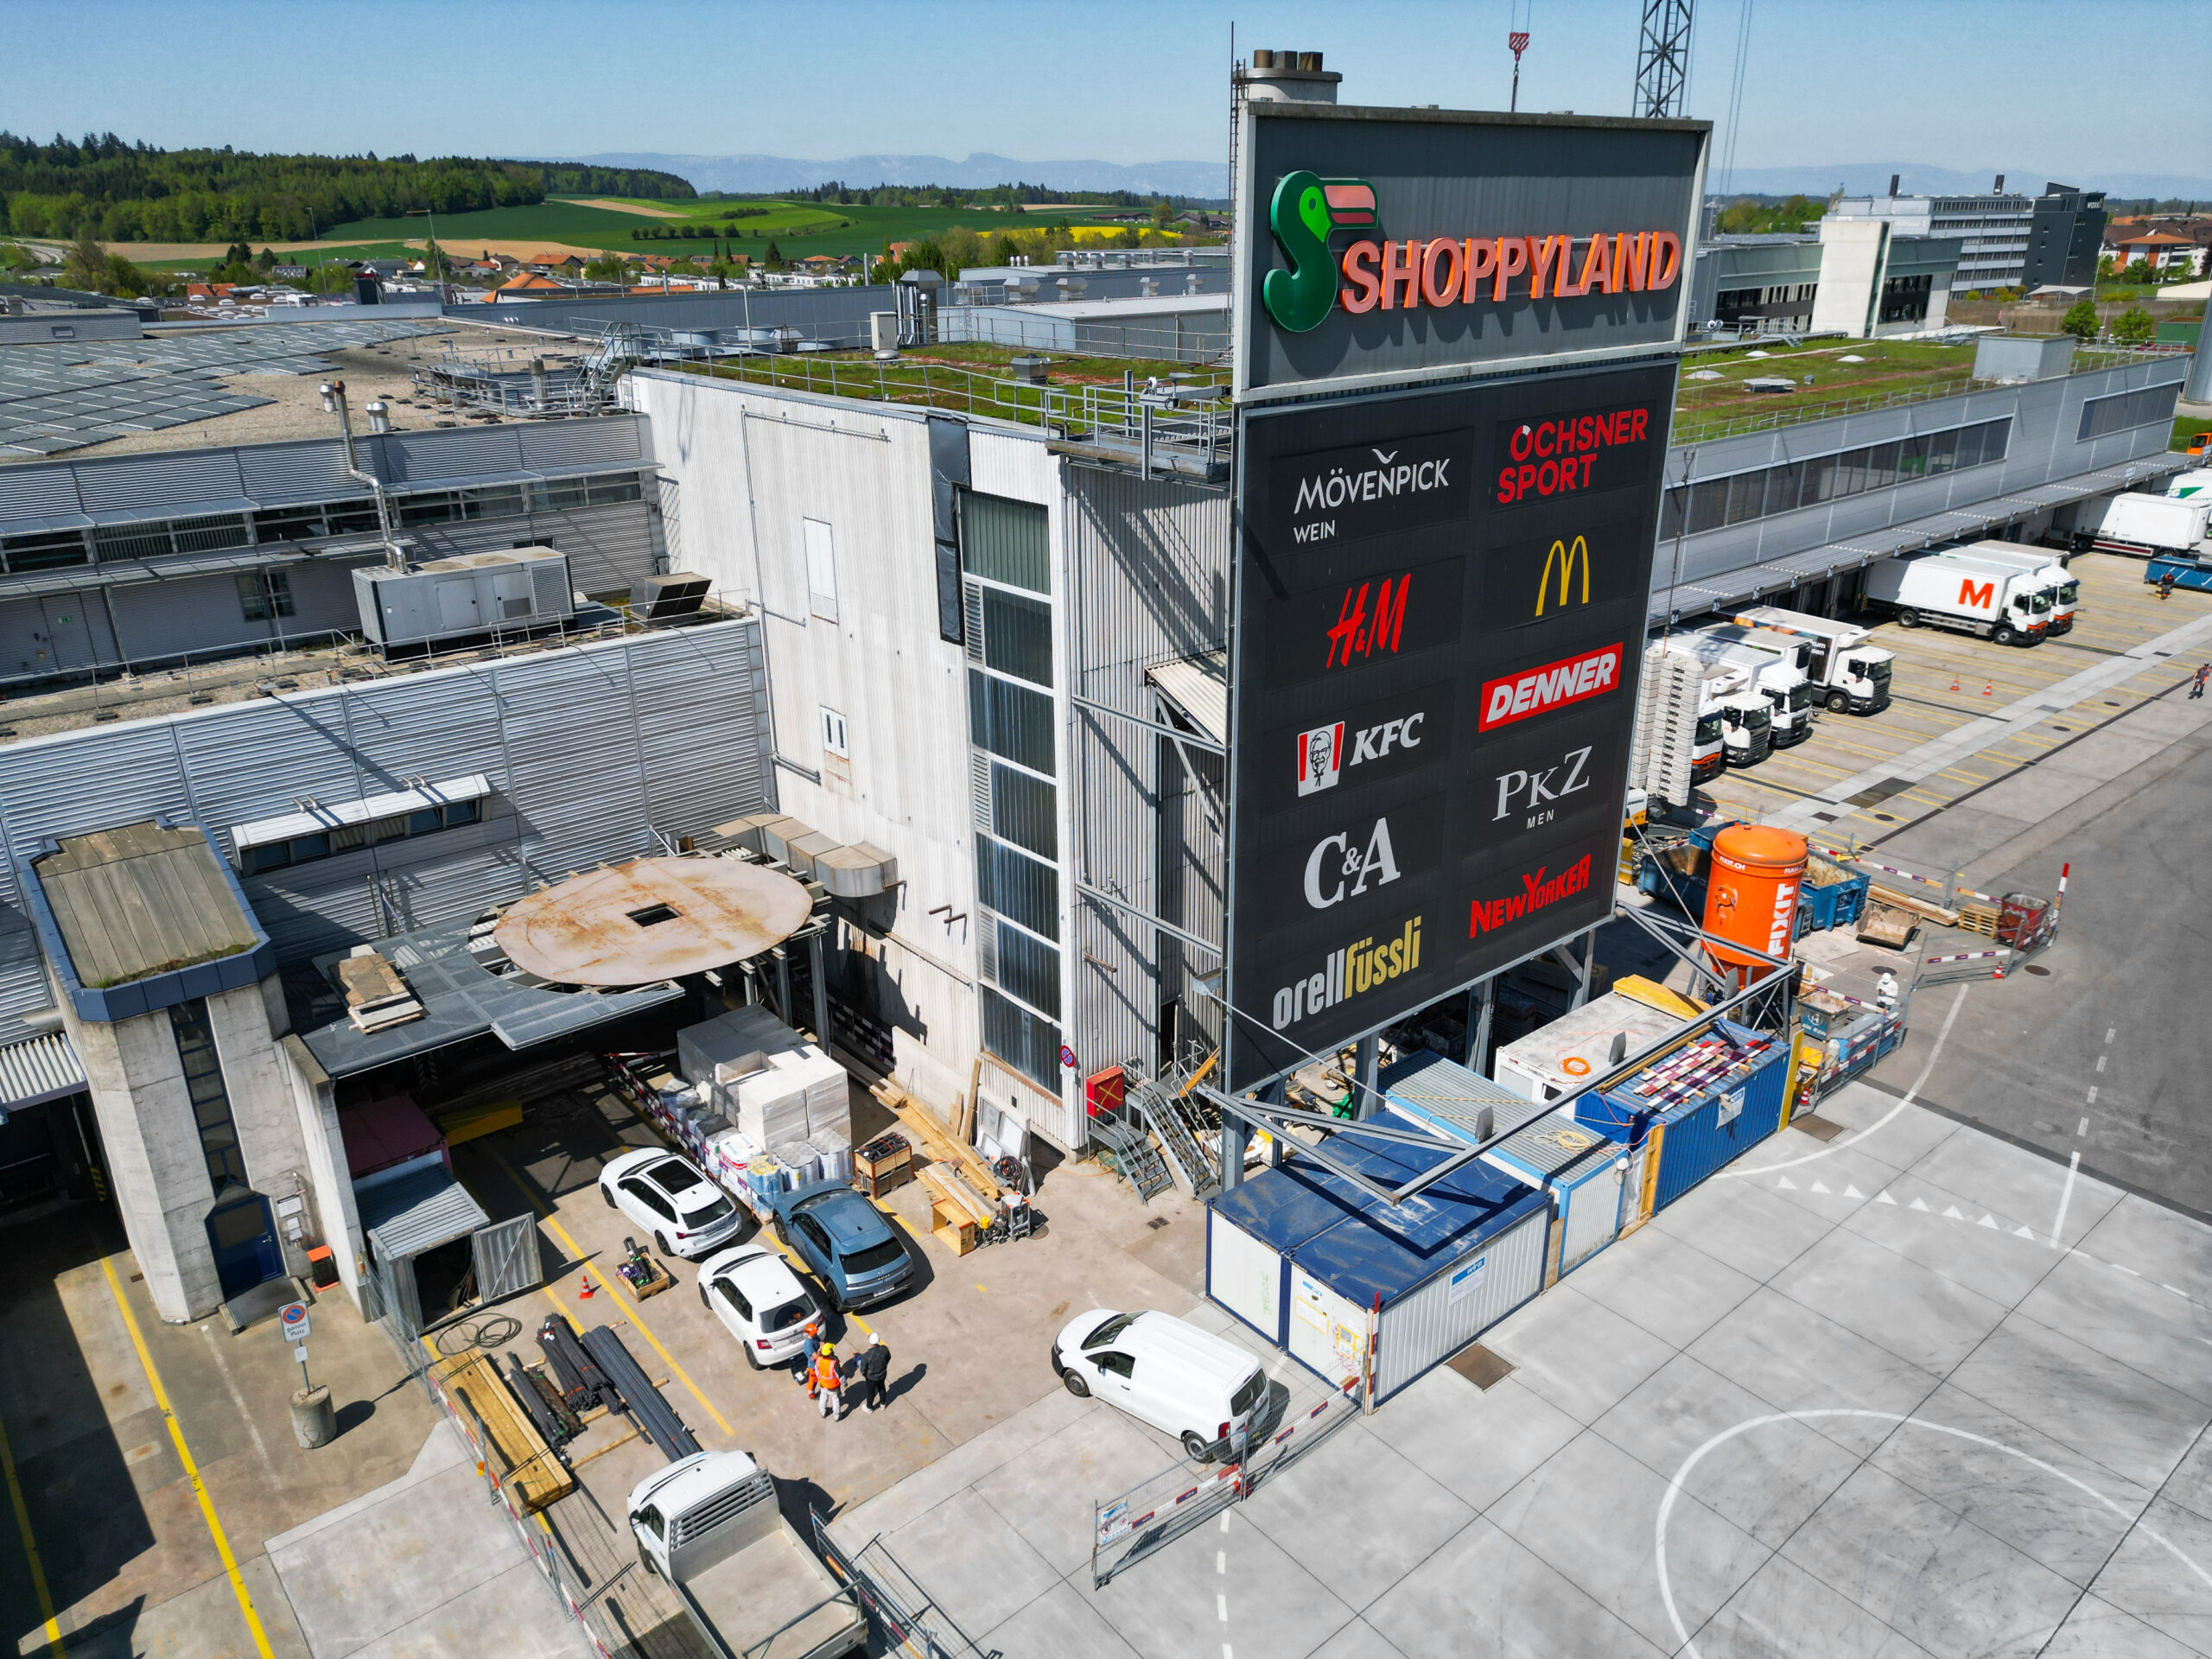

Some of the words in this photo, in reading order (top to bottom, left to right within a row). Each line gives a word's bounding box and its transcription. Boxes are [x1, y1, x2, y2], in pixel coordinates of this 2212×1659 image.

[1340, 231, 1681, 314] SHOPPYLAND
[1294, 458, 1451, 515] MÖVENPICK
[1497, 454, 1597, 504] SPORT
[1293, 519, 1336, 544] WEIN
[1325, 573, 1412, 669] H&M
[1958, 578, 1995, 609] M
[1485, 652, 1617, 724] DENNER
[1349, 712, 1425, 766] KFC
[1491, 746, 1593, 822] PKZ
[1526, 809, 1555, 830] MEN
[1303, 817, 1402, 909] C&A
[1767, 883, 1795, 956] FIXIT
[1273, 915, 1422, 1031] orellfüssli
